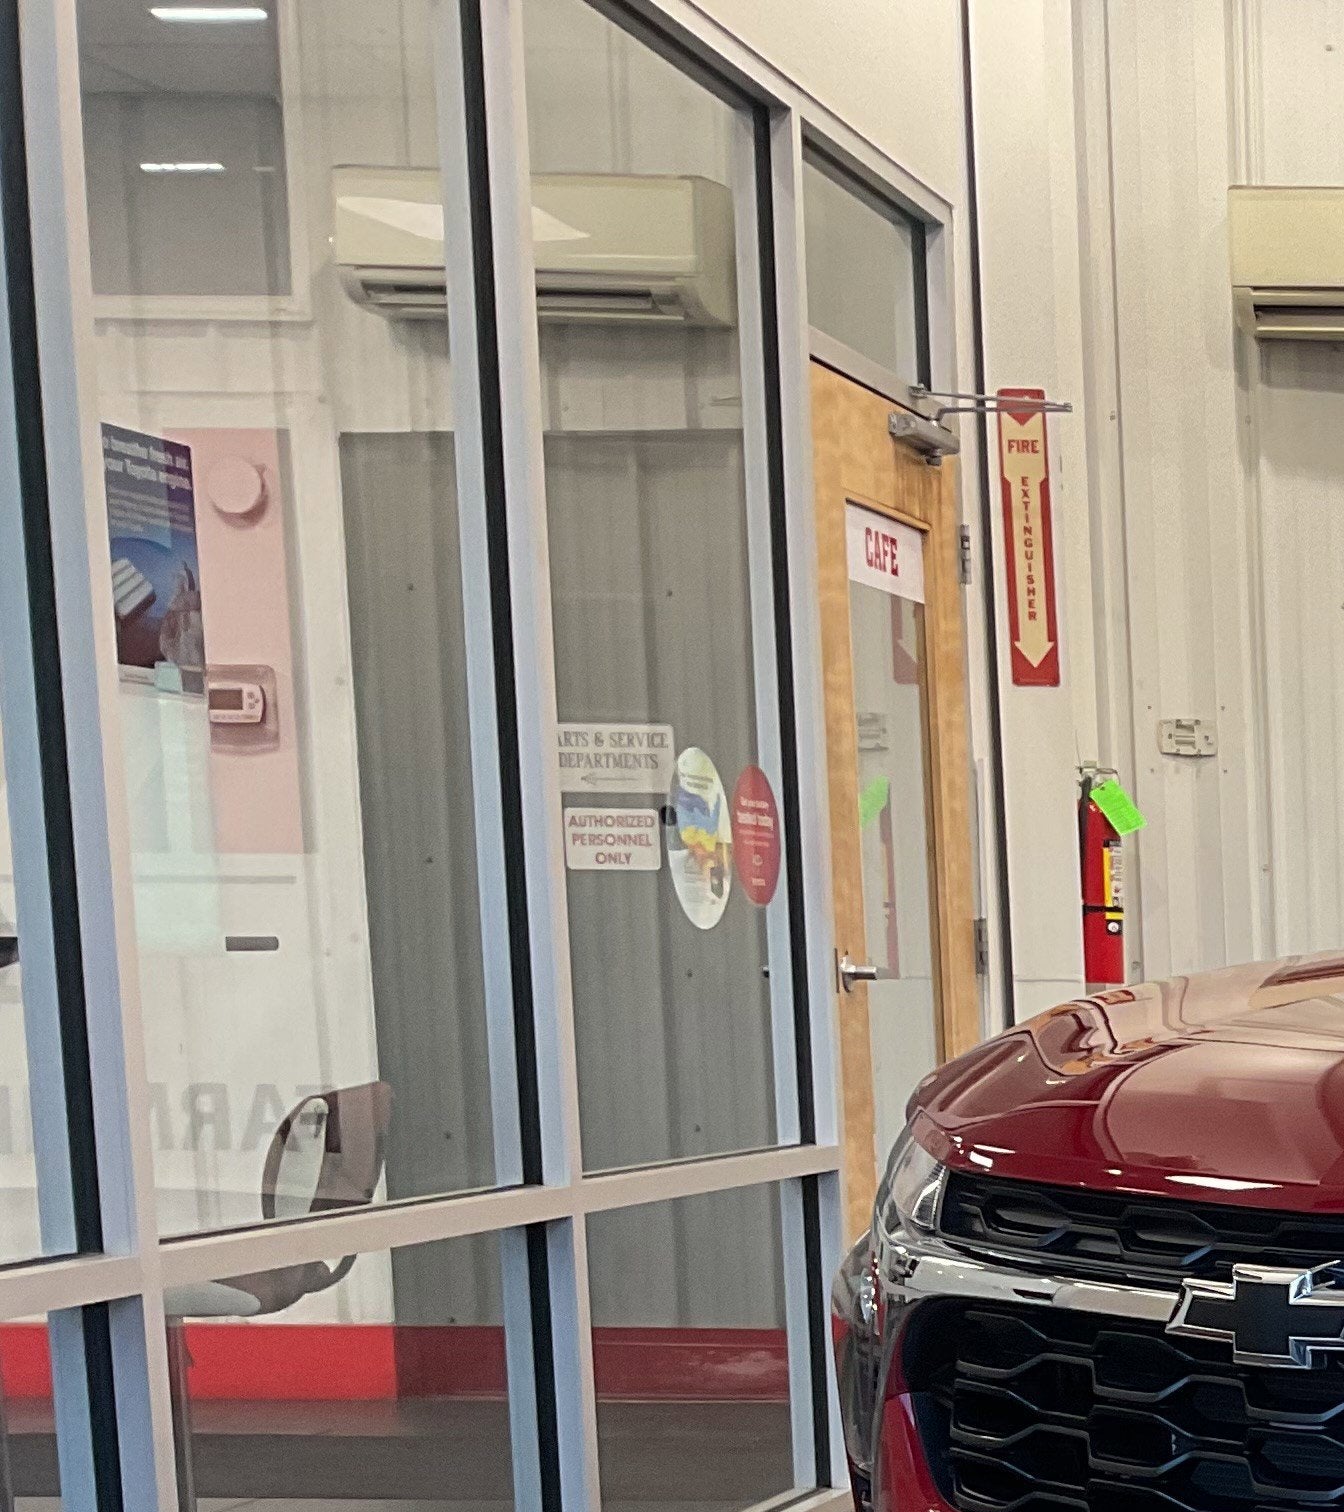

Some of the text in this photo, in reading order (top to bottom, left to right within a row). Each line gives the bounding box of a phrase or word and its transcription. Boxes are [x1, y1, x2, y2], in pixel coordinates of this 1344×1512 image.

[1007, 439, 1039, 454] FIRE
[865, 527, 899, 577] CAFE
[1020, 476, 1038, 621] EXTINGUISHER
[609, 732, 669, 749] SERVICE
[559, 752, 659, 769] DEPARTMENTS
[568, 814, 656, 828] AUTHORIZED
[571, 833, 653, 847] PERSONNEL
[595, 852, 632, 865] ONLY
